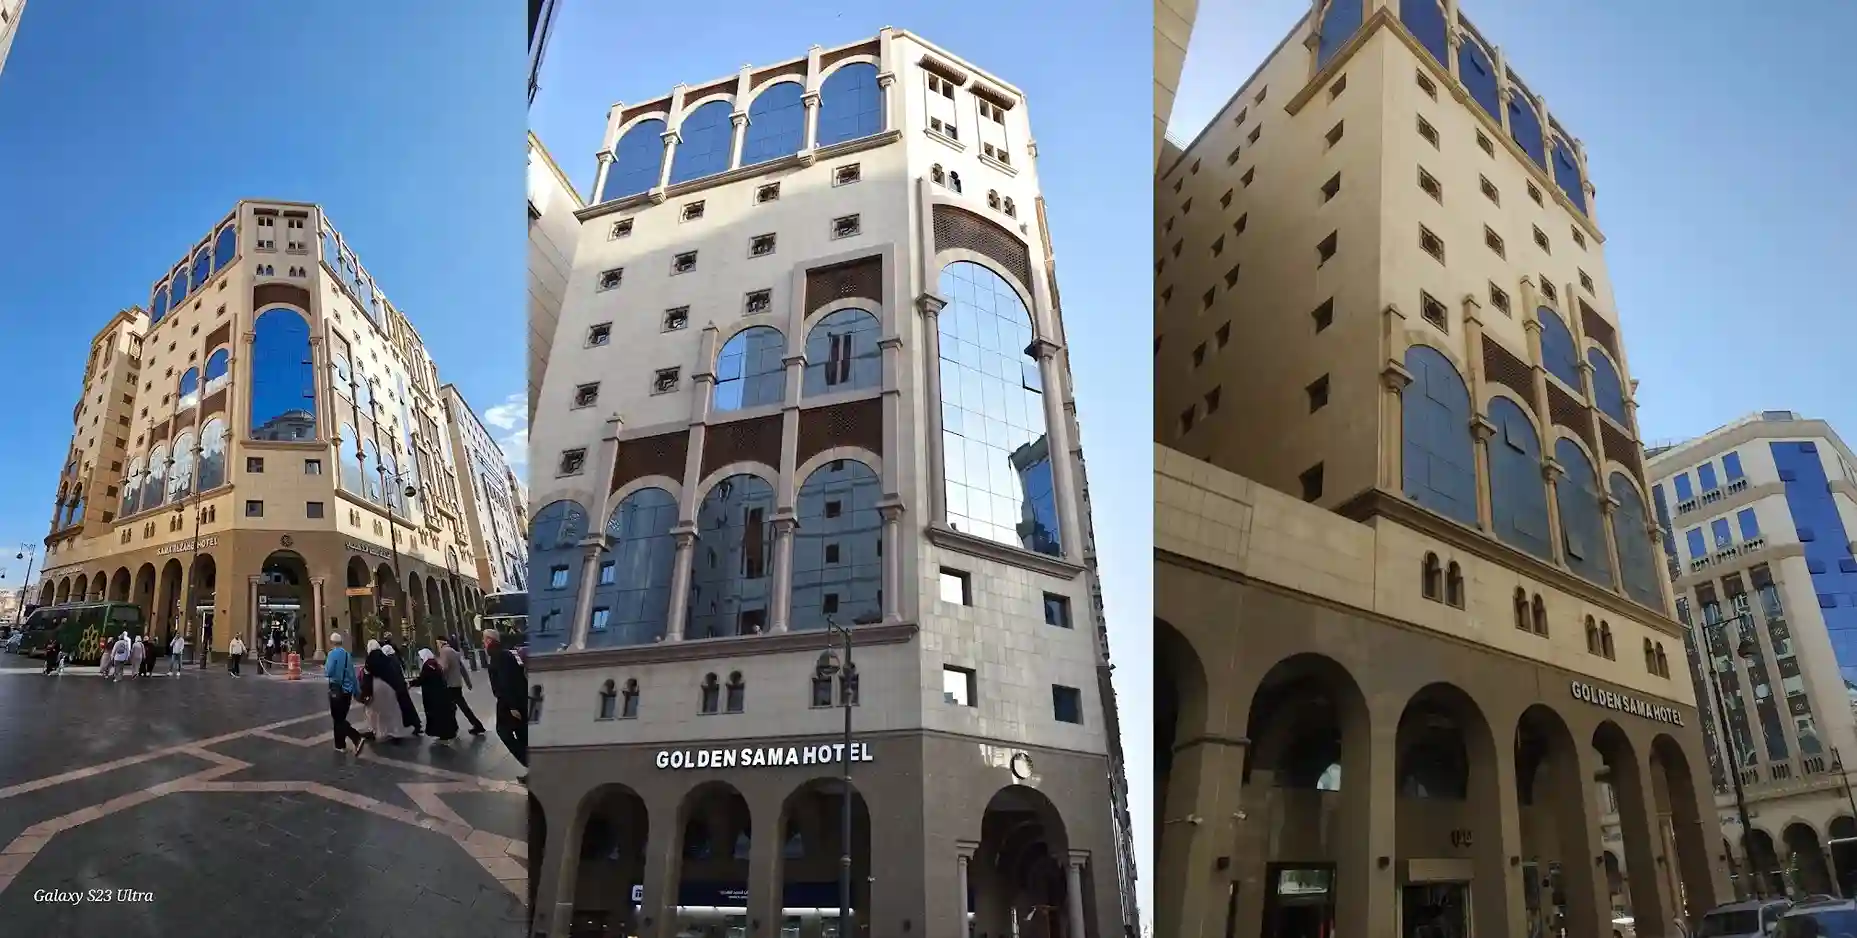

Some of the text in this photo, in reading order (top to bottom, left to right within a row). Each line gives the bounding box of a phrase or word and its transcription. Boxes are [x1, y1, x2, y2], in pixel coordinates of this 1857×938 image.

[1571, 680, 1685, 728] GOLDEN SAMA HOTEL
[656, 742, 873, 769] GOLDEN SAMA HOTEL
